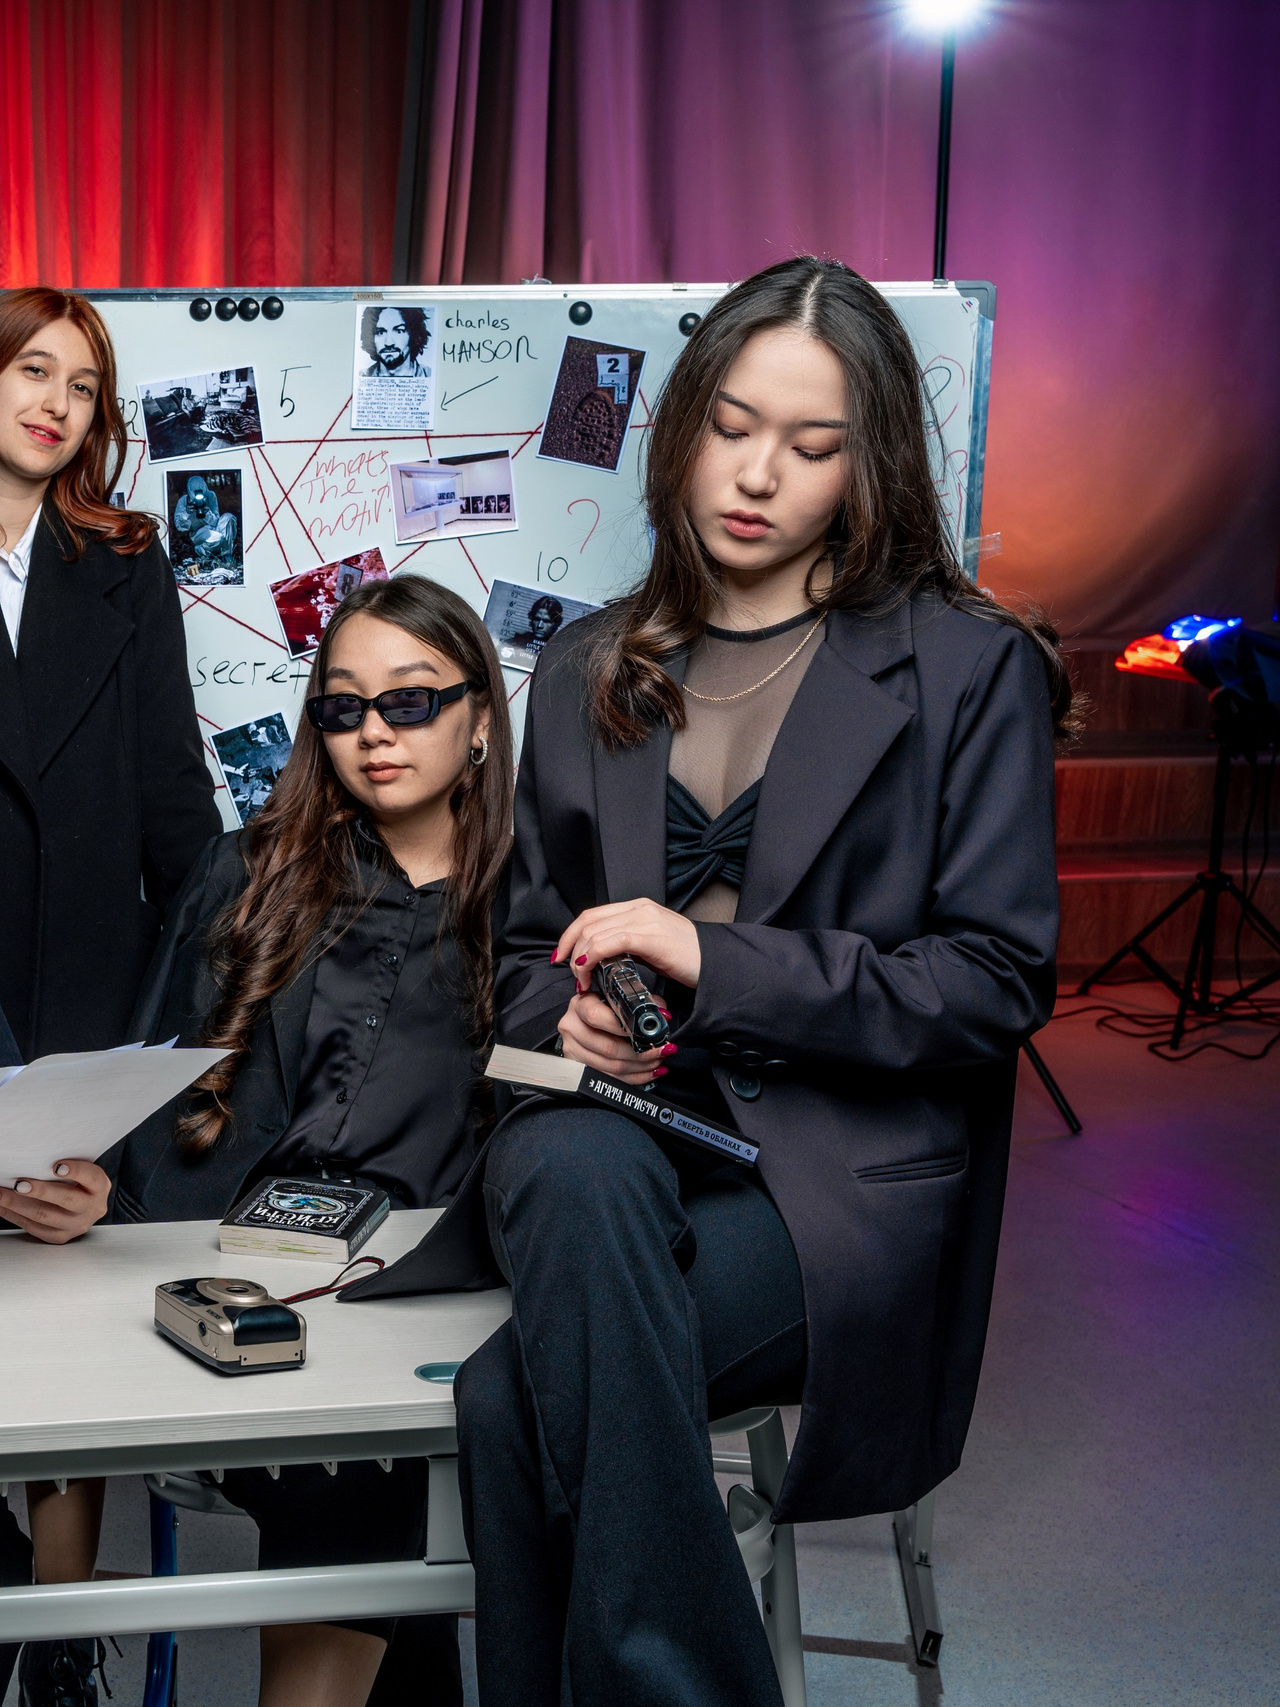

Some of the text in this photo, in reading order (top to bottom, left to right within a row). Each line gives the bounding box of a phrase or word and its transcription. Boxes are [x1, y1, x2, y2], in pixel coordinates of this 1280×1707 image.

[445, 310, 510, 331] charles
[607, 358, 620, 374] 2
[280, 365, 312, 418] 5
[536, 551, 569, 582] 10
[593, 1080, 659, 1117] АГАТА КРИСТИ
[677, 1118, 741, 1152] СМЕРТЬ В ОБЛАКАХ
